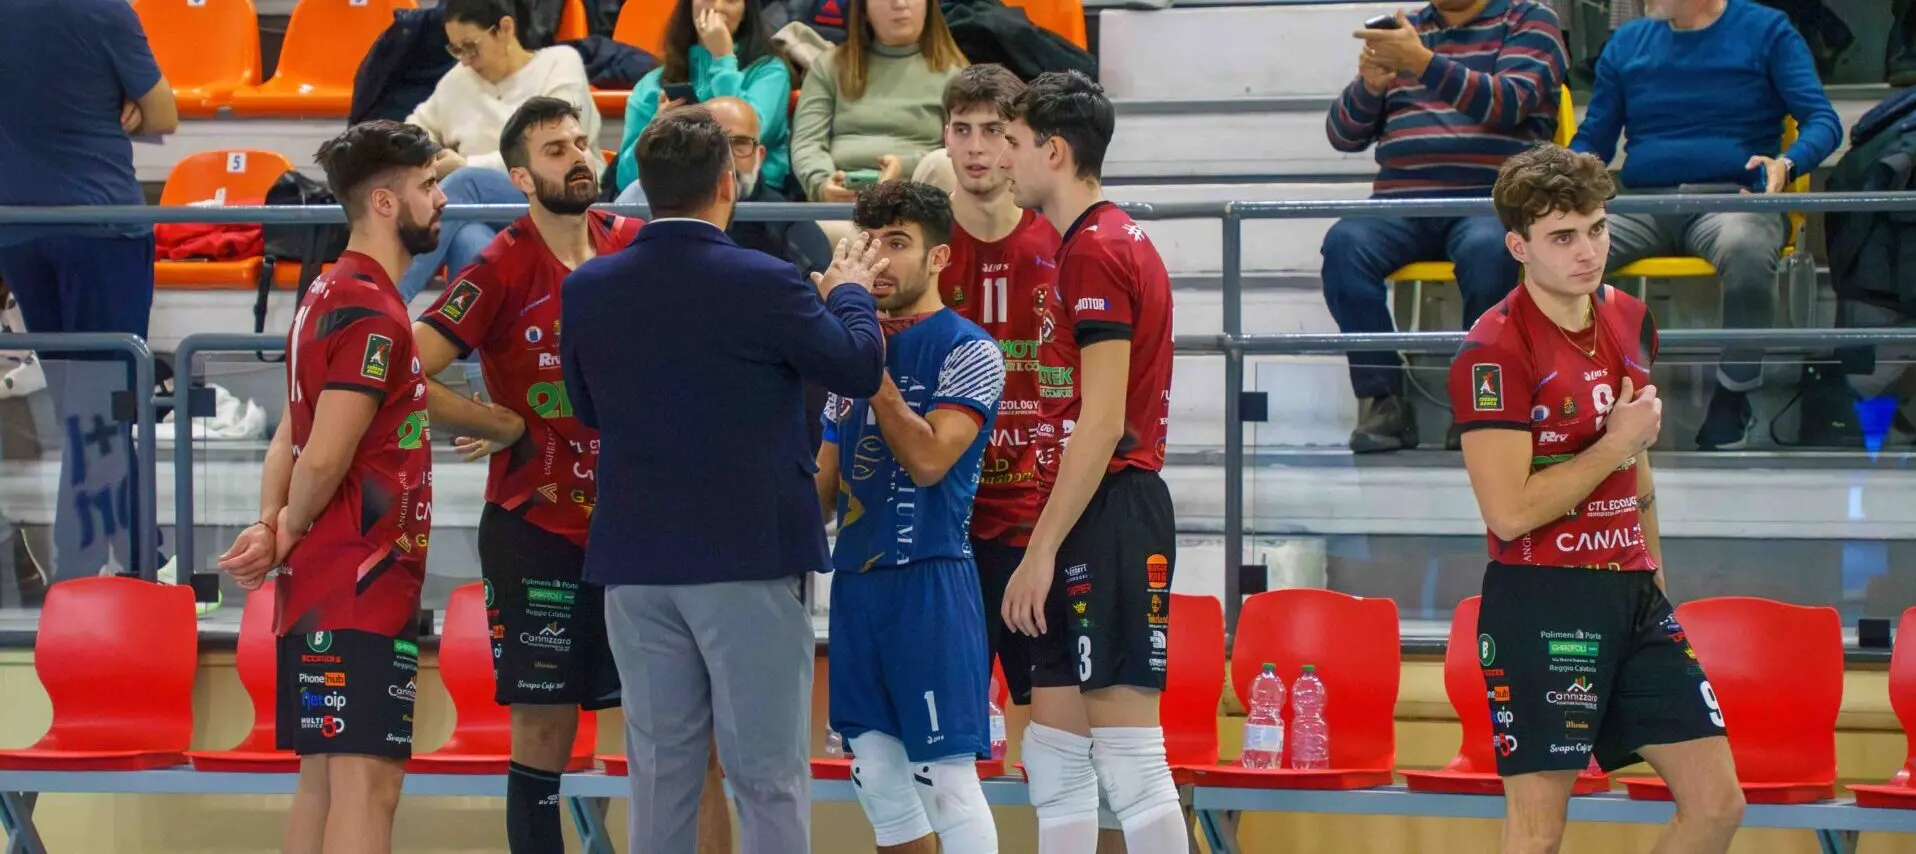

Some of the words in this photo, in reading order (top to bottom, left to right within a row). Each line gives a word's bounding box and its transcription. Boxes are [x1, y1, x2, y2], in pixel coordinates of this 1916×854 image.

[233, 155, 241, 170] 5
[983, 276, 1008, 324] 11
[1078, 635, 1092, 682] 3
[924, 690, 940, 732] 1
[1546, 690, 1598, 703] Cannizzaro
[1700, 680, 1726, 728] 9
